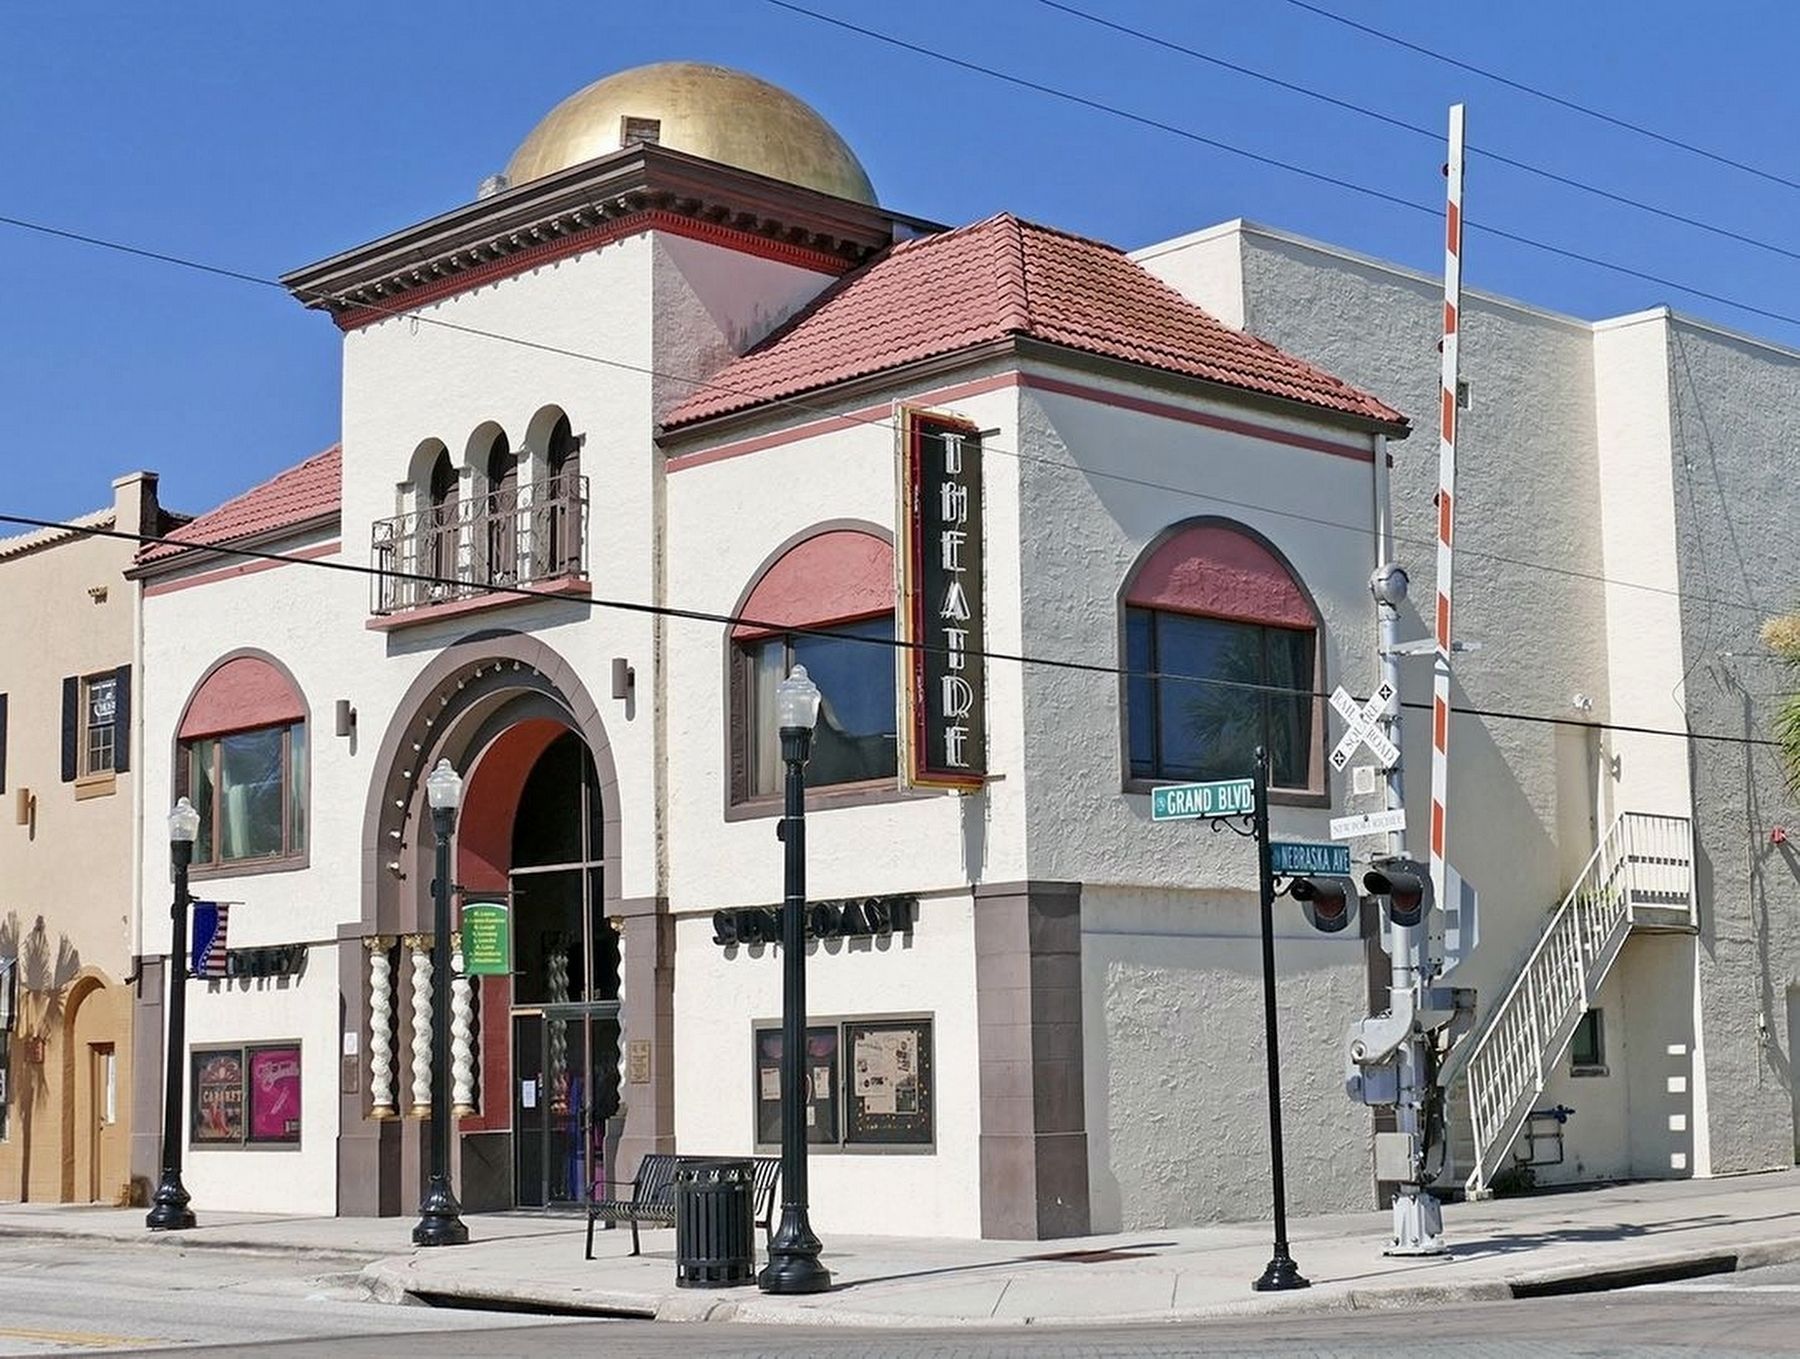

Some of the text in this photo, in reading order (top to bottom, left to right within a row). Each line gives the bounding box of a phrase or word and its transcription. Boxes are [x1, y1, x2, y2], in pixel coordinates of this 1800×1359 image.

[940, 433, 972, 767] THEATRE
[1167, 784, 1251, 814] GRAND BLVD
[1282, 846, 1349, 872] NEBRASKA AVE
